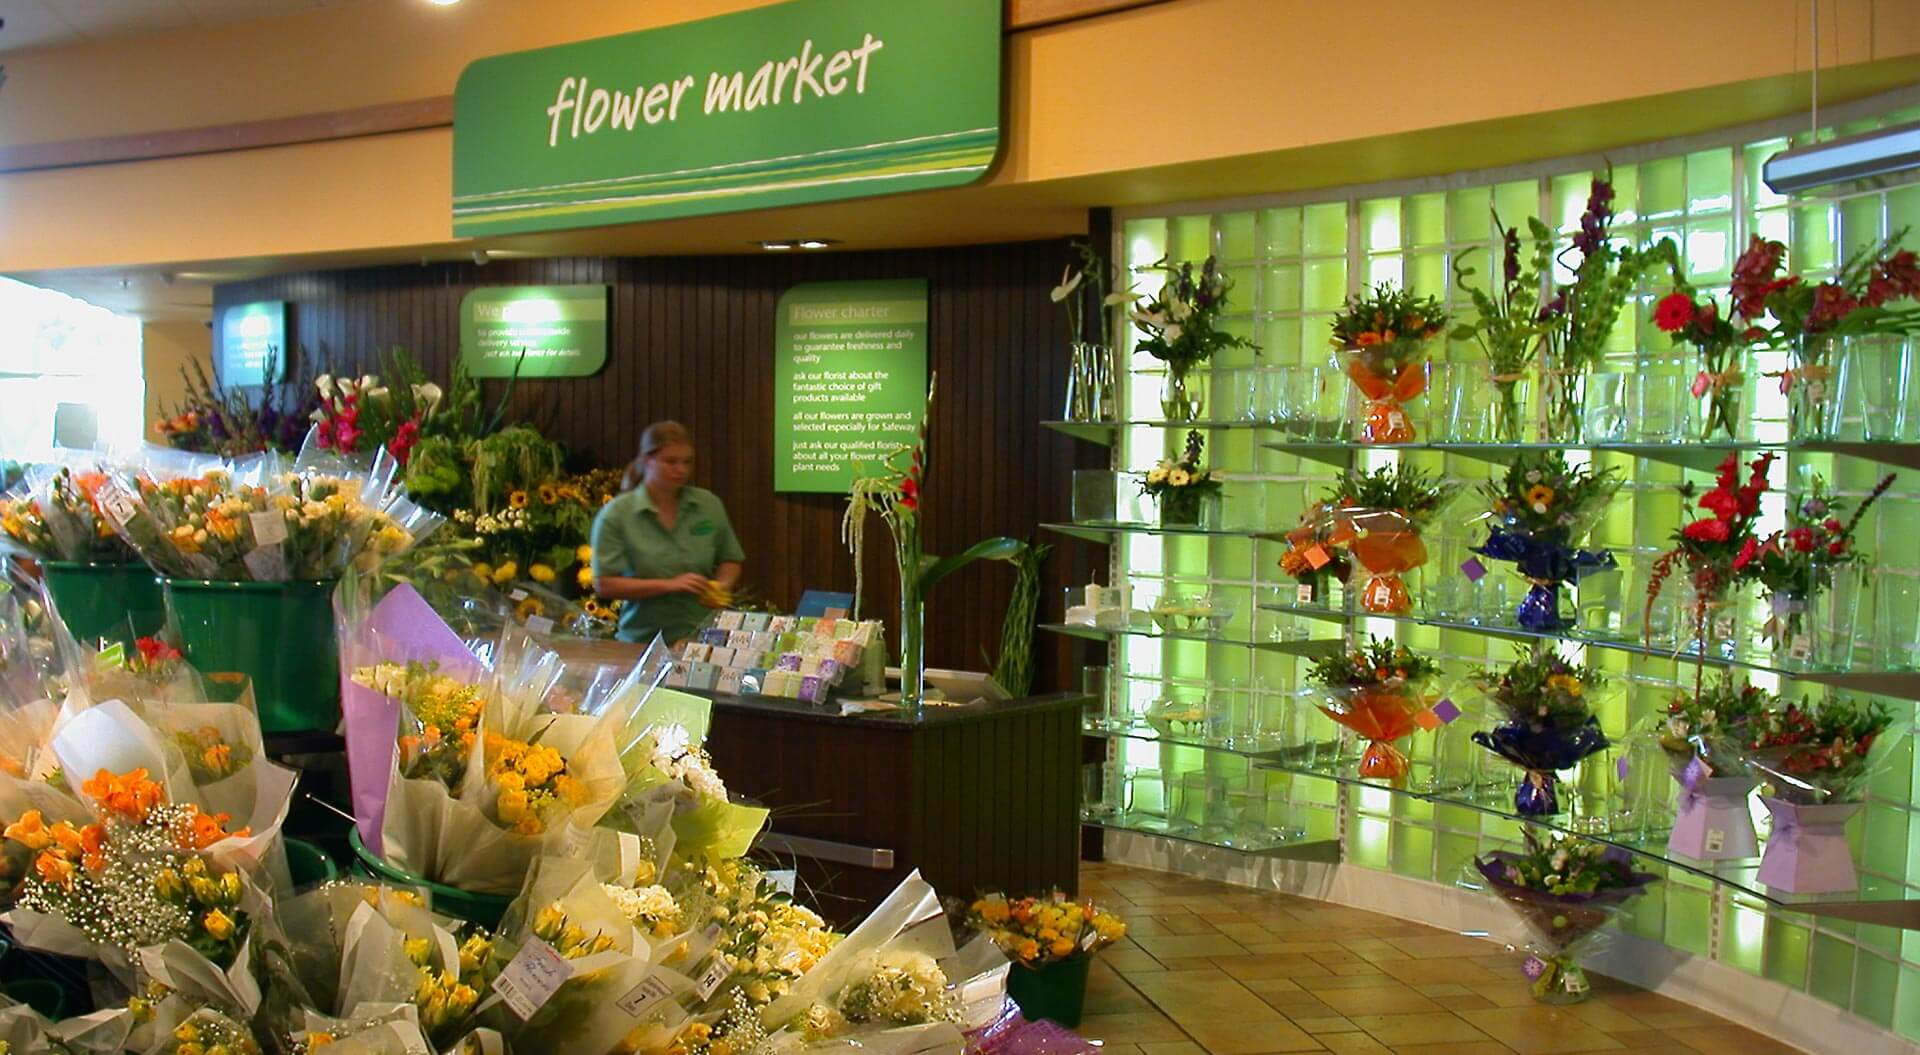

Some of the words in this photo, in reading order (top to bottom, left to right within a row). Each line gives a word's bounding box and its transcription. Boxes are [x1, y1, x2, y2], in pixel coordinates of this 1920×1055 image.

[547, 76, 694, 147] flower
[704, 33, 883, 115] market
[794, 305, 836, 319] Flower
[841, 304, 889, 318] charter
[793, 333, 808, 341] our
[809, 331, 839, 340] flowers
[840, 332, 853, 340] are
[855, 330, 893, 340] delivered
[895, 329, 915, 341] daily
[793, 343, 802, 351] to
[804, 343, 844, 353] guarantee
[847, 341, 884, 350] freshness
[886, 341, 903, 350] and
[793, 354, 821, 364] quality
[824, 371, 847, 380] florist
[848, 371, 873, 380] about
[874, 371, 889, 379] the
[793, 382, 826, 391] fantastic
[828, 381, 856, 391] choice
[857, 381, 866, 390] of
[867, 381, 882, 393] gift
[793, 393, 829, 404] products
[831, 392, 865, 402] available
[793, 411, 803, 419] all
[820, 410, 849, 420] flowers
[865, 412, 893, 421] grown
[895, 411, 912, 419] and
[793, 422, 826, 431] selected
[827, 422, 866, 432] especially
[867, 421, 880, 430] for
[882, 422, 916, 432] Safeway
[793, 440, 808, 450] just
[809, 440, 822, 449] ask
[840, 440, 875, 451] qualified
[793, 452, 817, 460] about
[819, 451, 829, 460] all
[830, 453, 848, 462] your
[850, 451, 876, 460] flower
[793, 462, 814, 472] plant
[815, 462, 840, 471] needs
